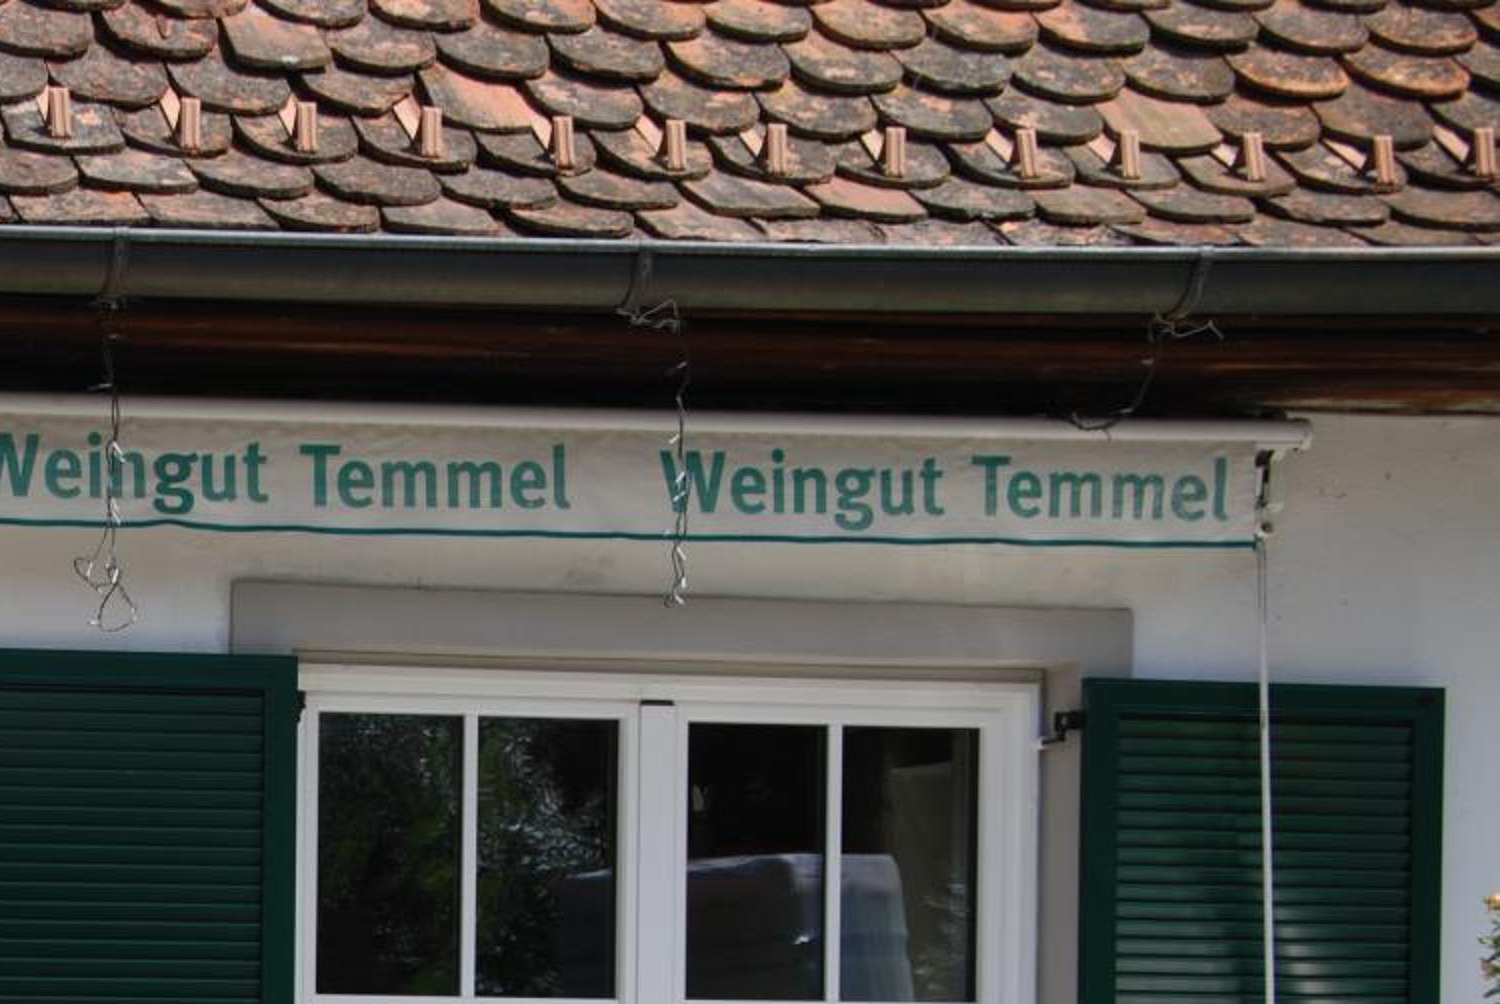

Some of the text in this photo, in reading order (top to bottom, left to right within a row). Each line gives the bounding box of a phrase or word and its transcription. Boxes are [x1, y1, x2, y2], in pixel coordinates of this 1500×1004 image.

[299, 442, 571, 511] Temmel
[660, 448, 944, 530] Weingut
[971, 454, 1229, 522] Temmel
